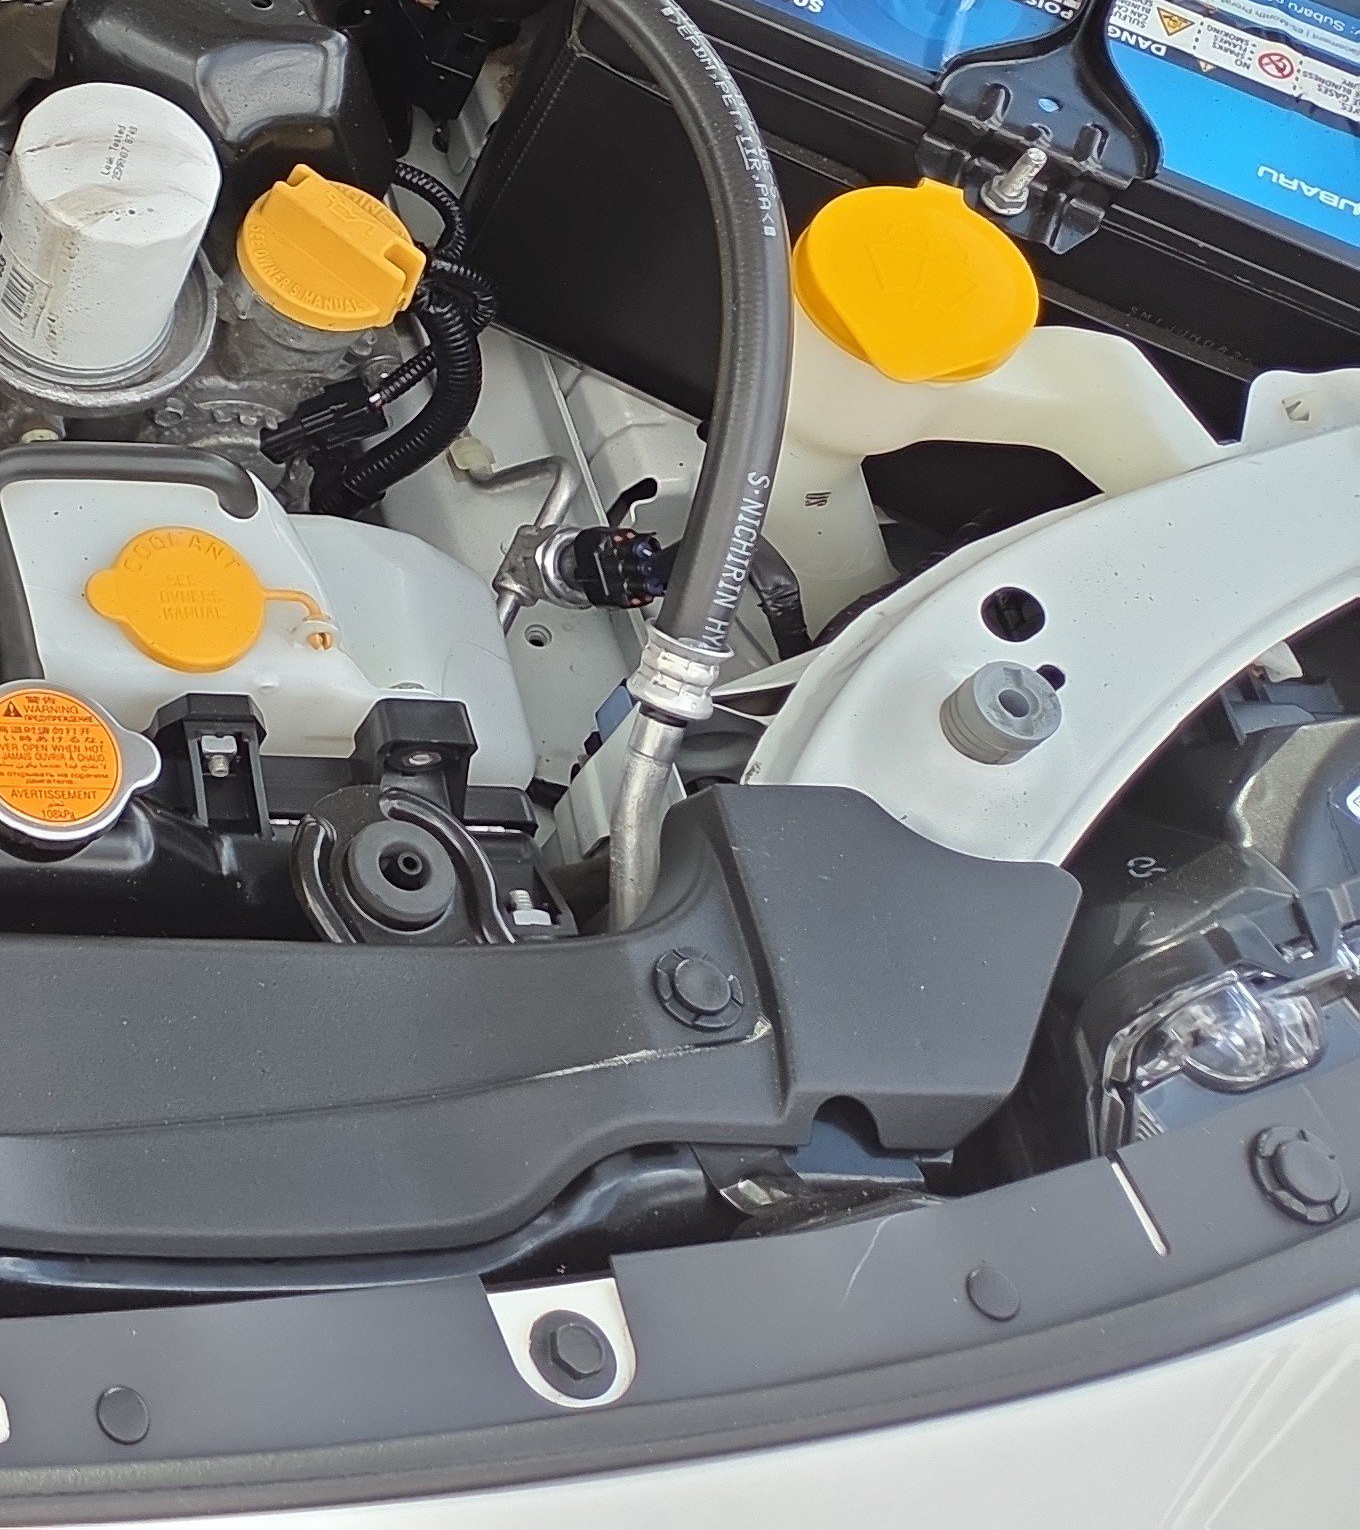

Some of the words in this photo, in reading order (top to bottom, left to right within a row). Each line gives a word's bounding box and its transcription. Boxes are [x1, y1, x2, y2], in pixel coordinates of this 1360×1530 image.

[1111, 9, 1146, 28] SULFU
[1129, 9, 1148, 20] CAN
[1287, 1, 1346, 32] Subaru
[1105, 24, 1167, 56] DANG
[1205, 23, 1250, 46] SMOKING
[1212, 34, 1247, 52] FLAMES
[1211, 41, 1245, 58] SPARKS
[1233, 58, 1250, 69] NO
[1301, 70, 1352, 95] BLINDNESS
[1315, 83, 1350, 102] GASES
[301, 290, 364, 312] MANUAL
[123, 533, 241, 574] COOLANT
[23, 705, 78, 714] WARNING
[2, 752, 32, 760] JAMAIS
[35, 753, 66, 761] OUVRIR
[22, 743, 48, 752] OPEN
[52, 744, 80, 752] WHEN
[11, 789, 96, 799] AVERTISSEMENT
[41, 810, 75, 819] 108kPa
